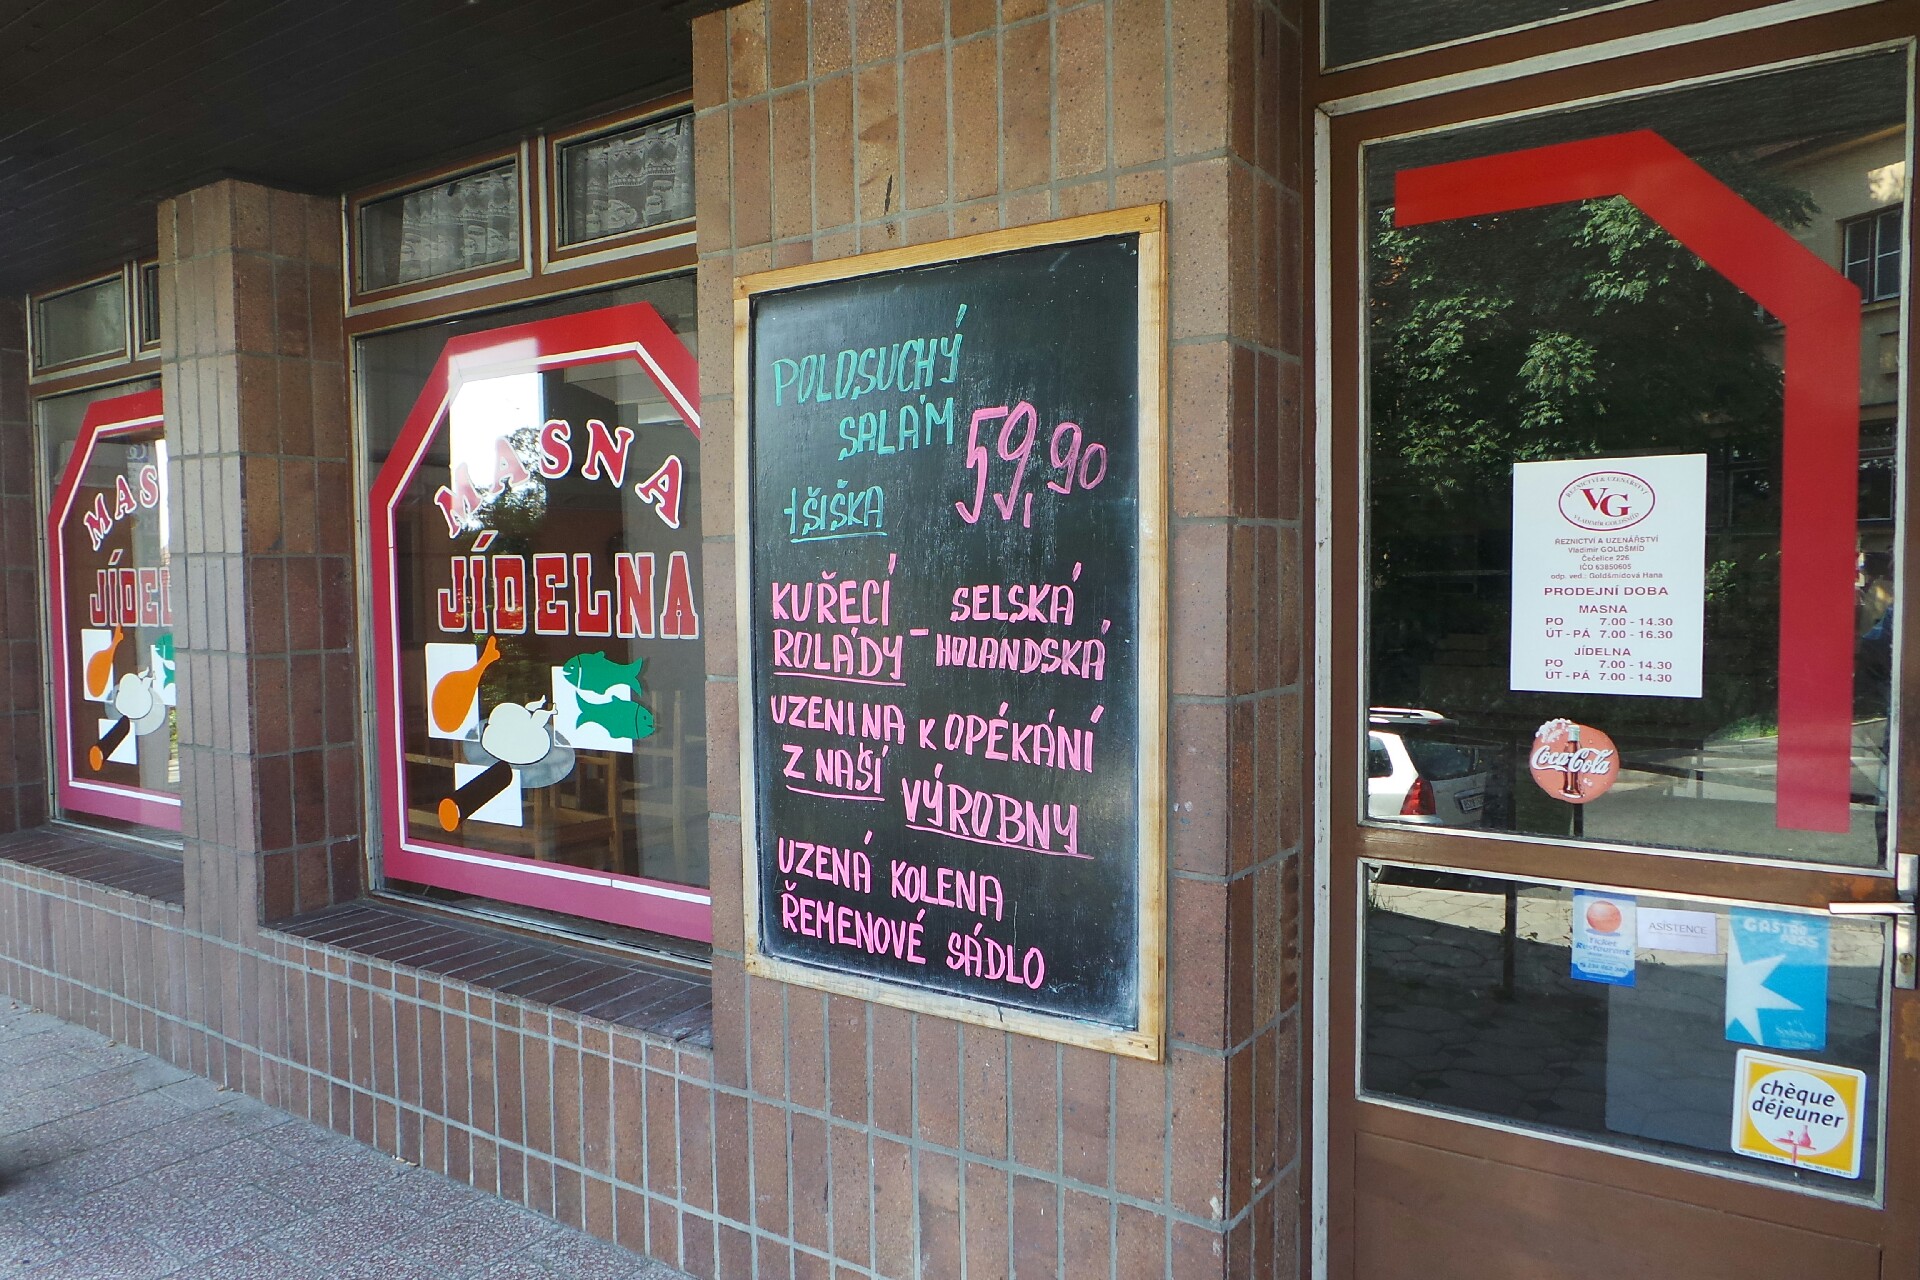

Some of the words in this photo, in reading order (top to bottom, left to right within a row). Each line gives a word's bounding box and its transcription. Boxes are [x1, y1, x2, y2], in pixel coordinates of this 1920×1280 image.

[838, 395, 954, 460] SALÁM
[434, 419, 682, 539] MASNA
[1580, 487, 1632, 517] VG
[438, 530, 699, 639] JÍDELNA
[771, 553, 897, 627] KUŘECÍ
[950, 561, 1082, 626] SELSKÁ
[1544, 585, 1620, 596] PRODEJNÍ
[1624, 587, 1669, 596] DOBA
[1545, 617, 1564, 626] PO
[1599, 617, 1626, 626] 7.00
[1639, 617, 1673, 626] 14.30
[1579, 604, 1628, 614] MASNA
[1545, 627, 1563, 638] ÚT
[1573, 628, 1590, 638] PÁ
[1599, 629, 1626, 639] 7.00
[1639, 629, 1673, 639] 16.30
[772, 627, 904, 681] ROLÁDY
[936, 619, 1111, 681] HOLANDSKÁ
[1545, 659, 1563, 667] PO
[1599, 660, 1626, 669] 7.00
[1638, 660, 1672, 670] 14.30
[1574, 645, 1631, 656] JÍDELNA
[1545, 669, 1562, 680] ÚT
[1572, 670, 1590, 680] PÁ
[1599, 672, 1626, 681] 7.00
[1638, 673, 1672, 682] 14.30
[770, 694, 905, 745] UZENINA
[944, 702, 1105, 774] OPÉKÁNÍ
[1531, 745, 1614, 774] Coca-Cola
[782, 744, 805, 780] Z
[815, 743, 889, 794] NAŠÍ
[901, 763, 1079, 854] VÝROBNY
[778, 831, 873, 893] UZENÁ
[891, 859, 1004, 922] KOLENA
[781, 880, 926, 965] ŘEMENOVÉ
[947, 923, 1045, 989] SÁDLO
[1760, 1079, 1836, 1107] chèque
[1752, 1096, 1844, 1128] déjeuner
